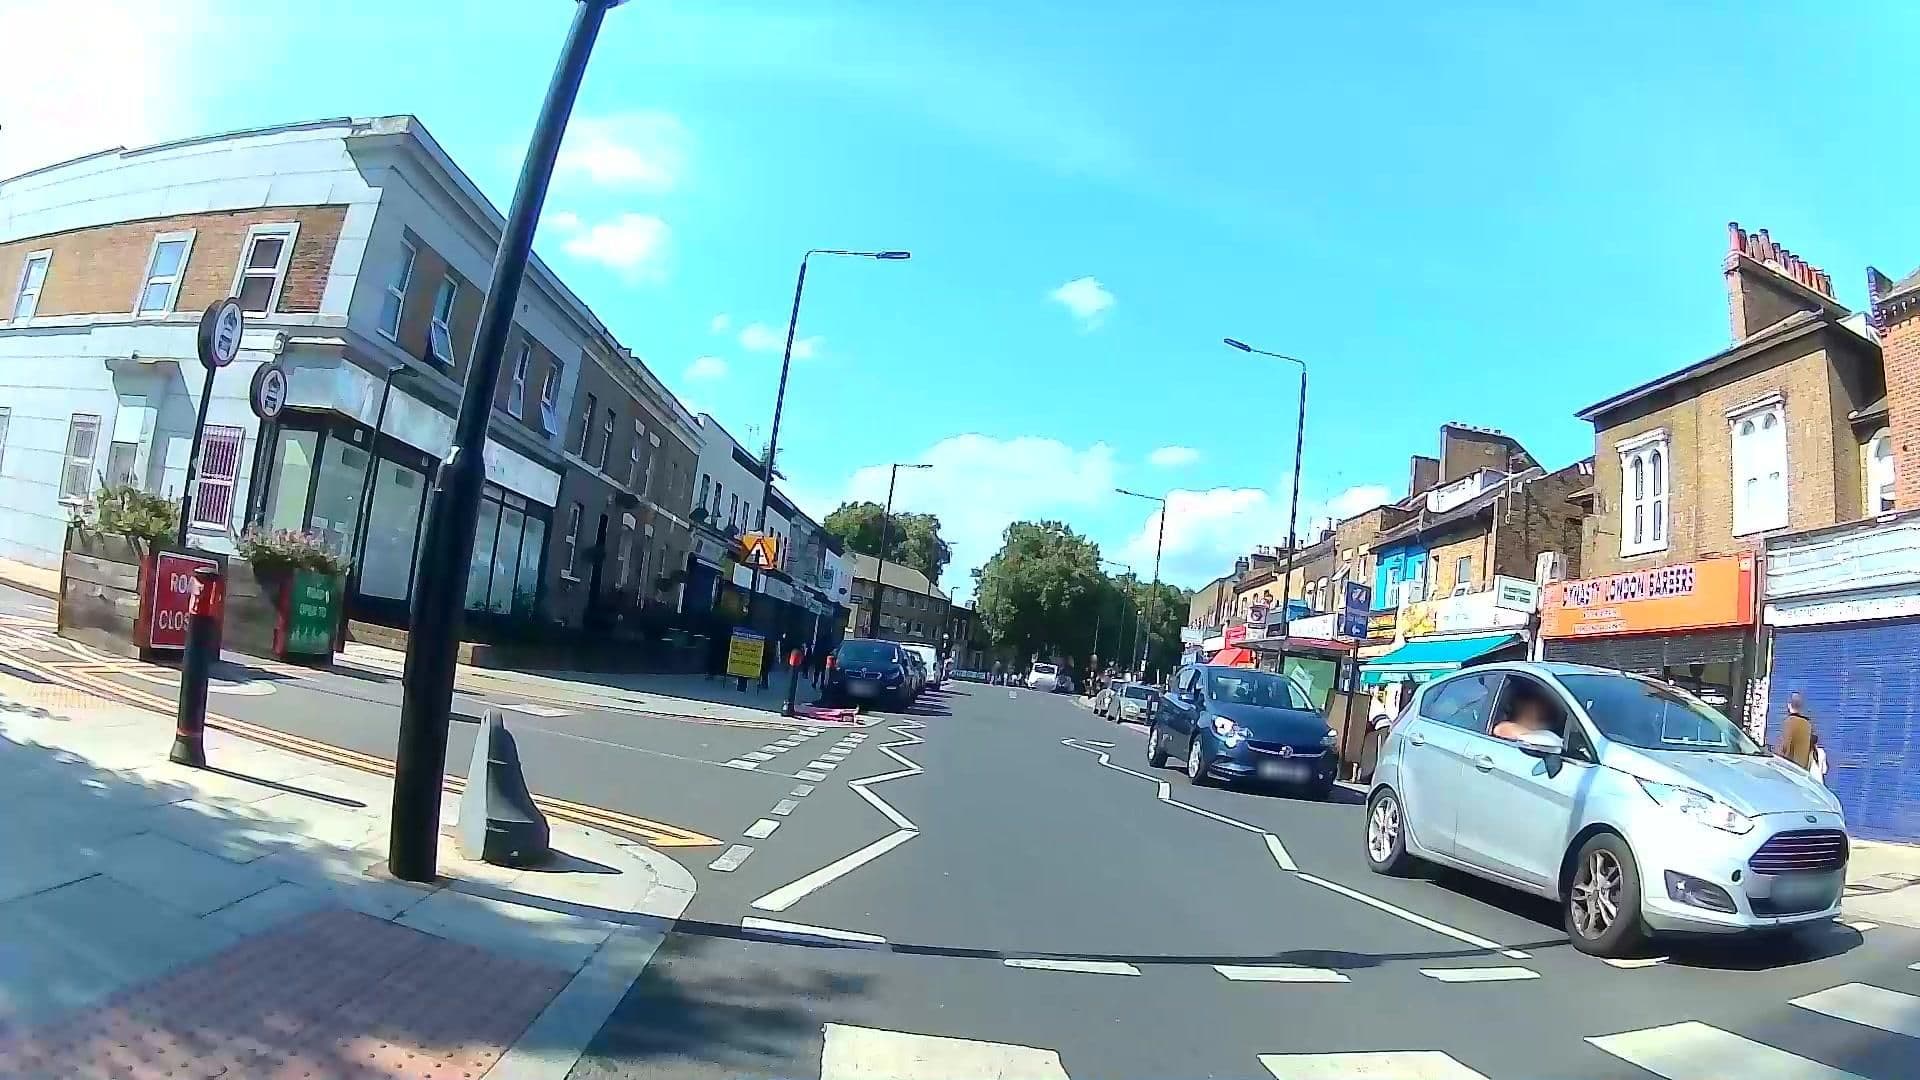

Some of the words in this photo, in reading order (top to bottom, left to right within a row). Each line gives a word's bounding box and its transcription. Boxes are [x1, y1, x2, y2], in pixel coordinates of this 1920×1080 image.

[170, 572, 194, 594] ROA
[1604, 575, 1644, 602] LONDON
[1649, 567, 1693, 597] BARBERS
[158, 609, 191, 631] CLOS
